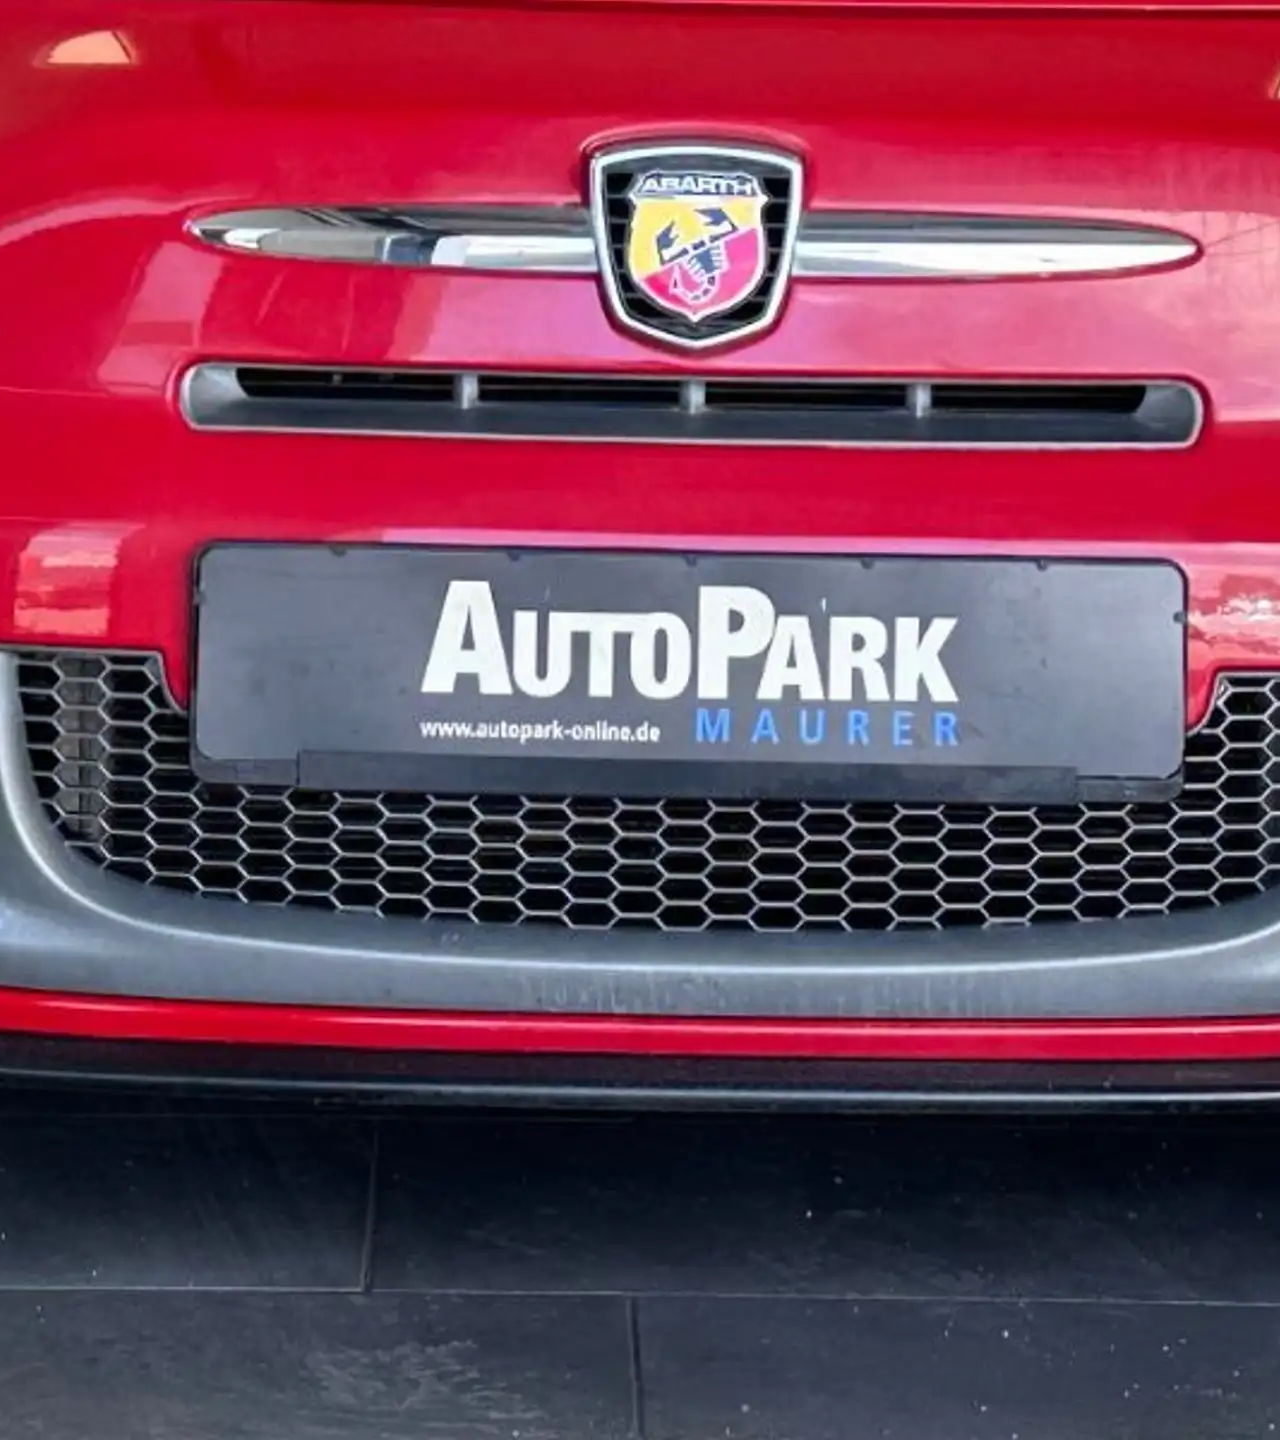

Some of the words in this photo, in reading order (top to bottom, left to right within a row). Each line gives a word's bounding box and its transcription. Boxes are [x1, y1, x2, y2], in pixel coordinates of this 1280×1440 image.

[641, 175, 754, 197] ABARTH
[419, 719, 662, 745] www.autopark-online.de
[695, 707, 959, 747] MAURER
